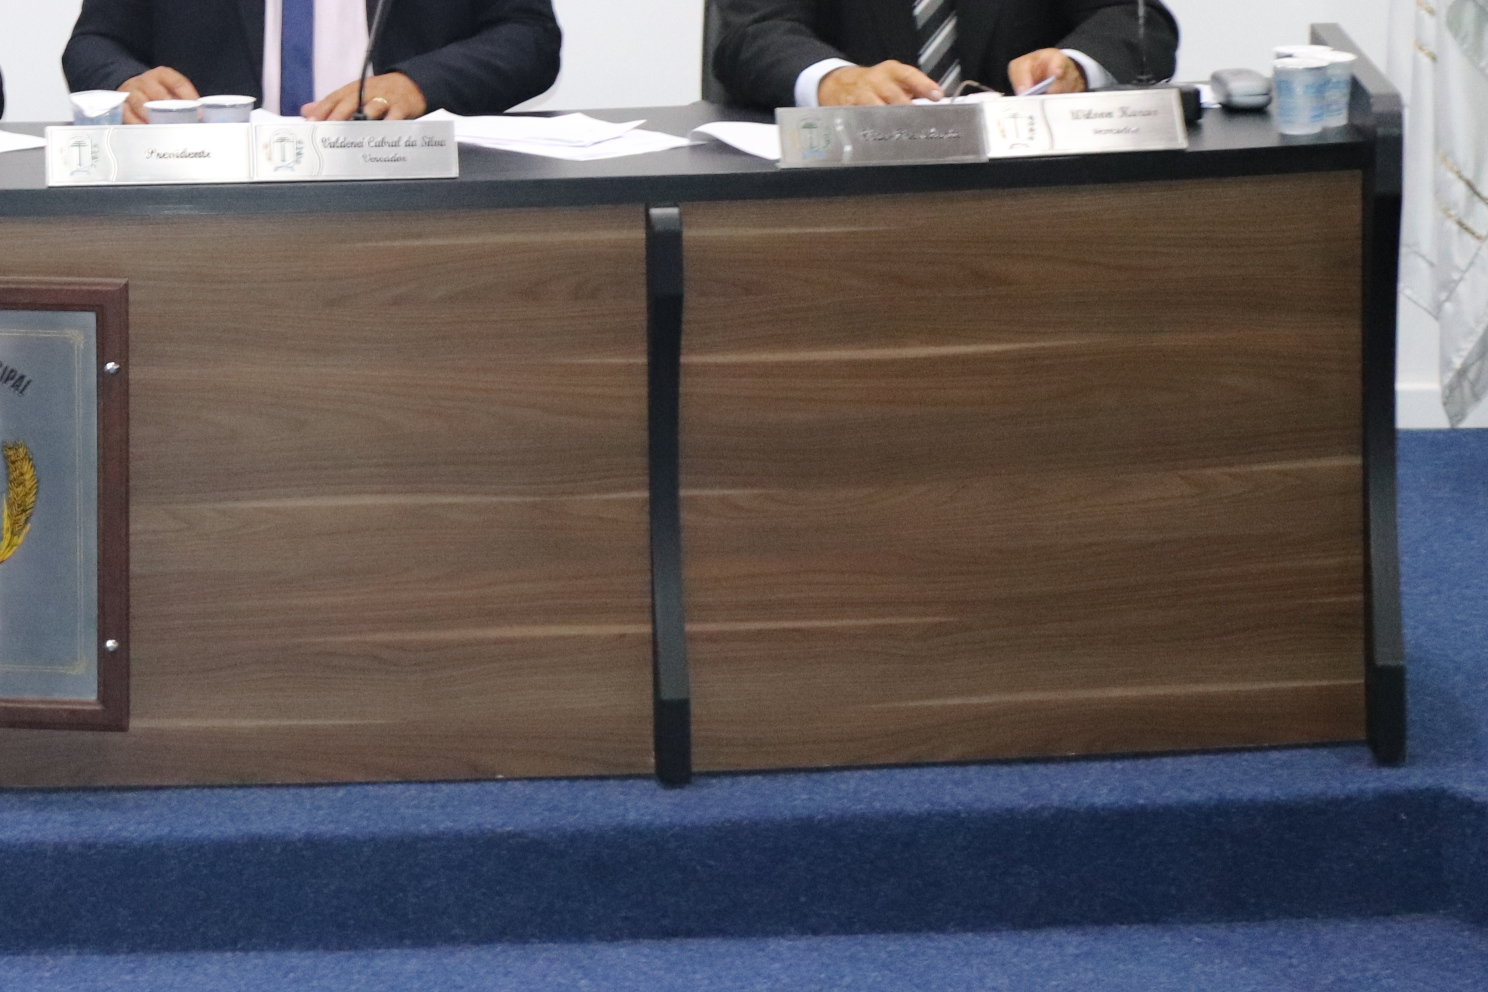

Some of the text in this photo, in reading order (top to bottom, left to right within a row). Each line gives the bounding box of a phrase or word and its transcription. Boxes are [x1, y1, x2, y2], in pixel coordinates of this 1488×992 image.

[367, 136, 401, 148] Cabral
[404, 136, 418, 148] da
[421, 136, 447, 148] Silva
